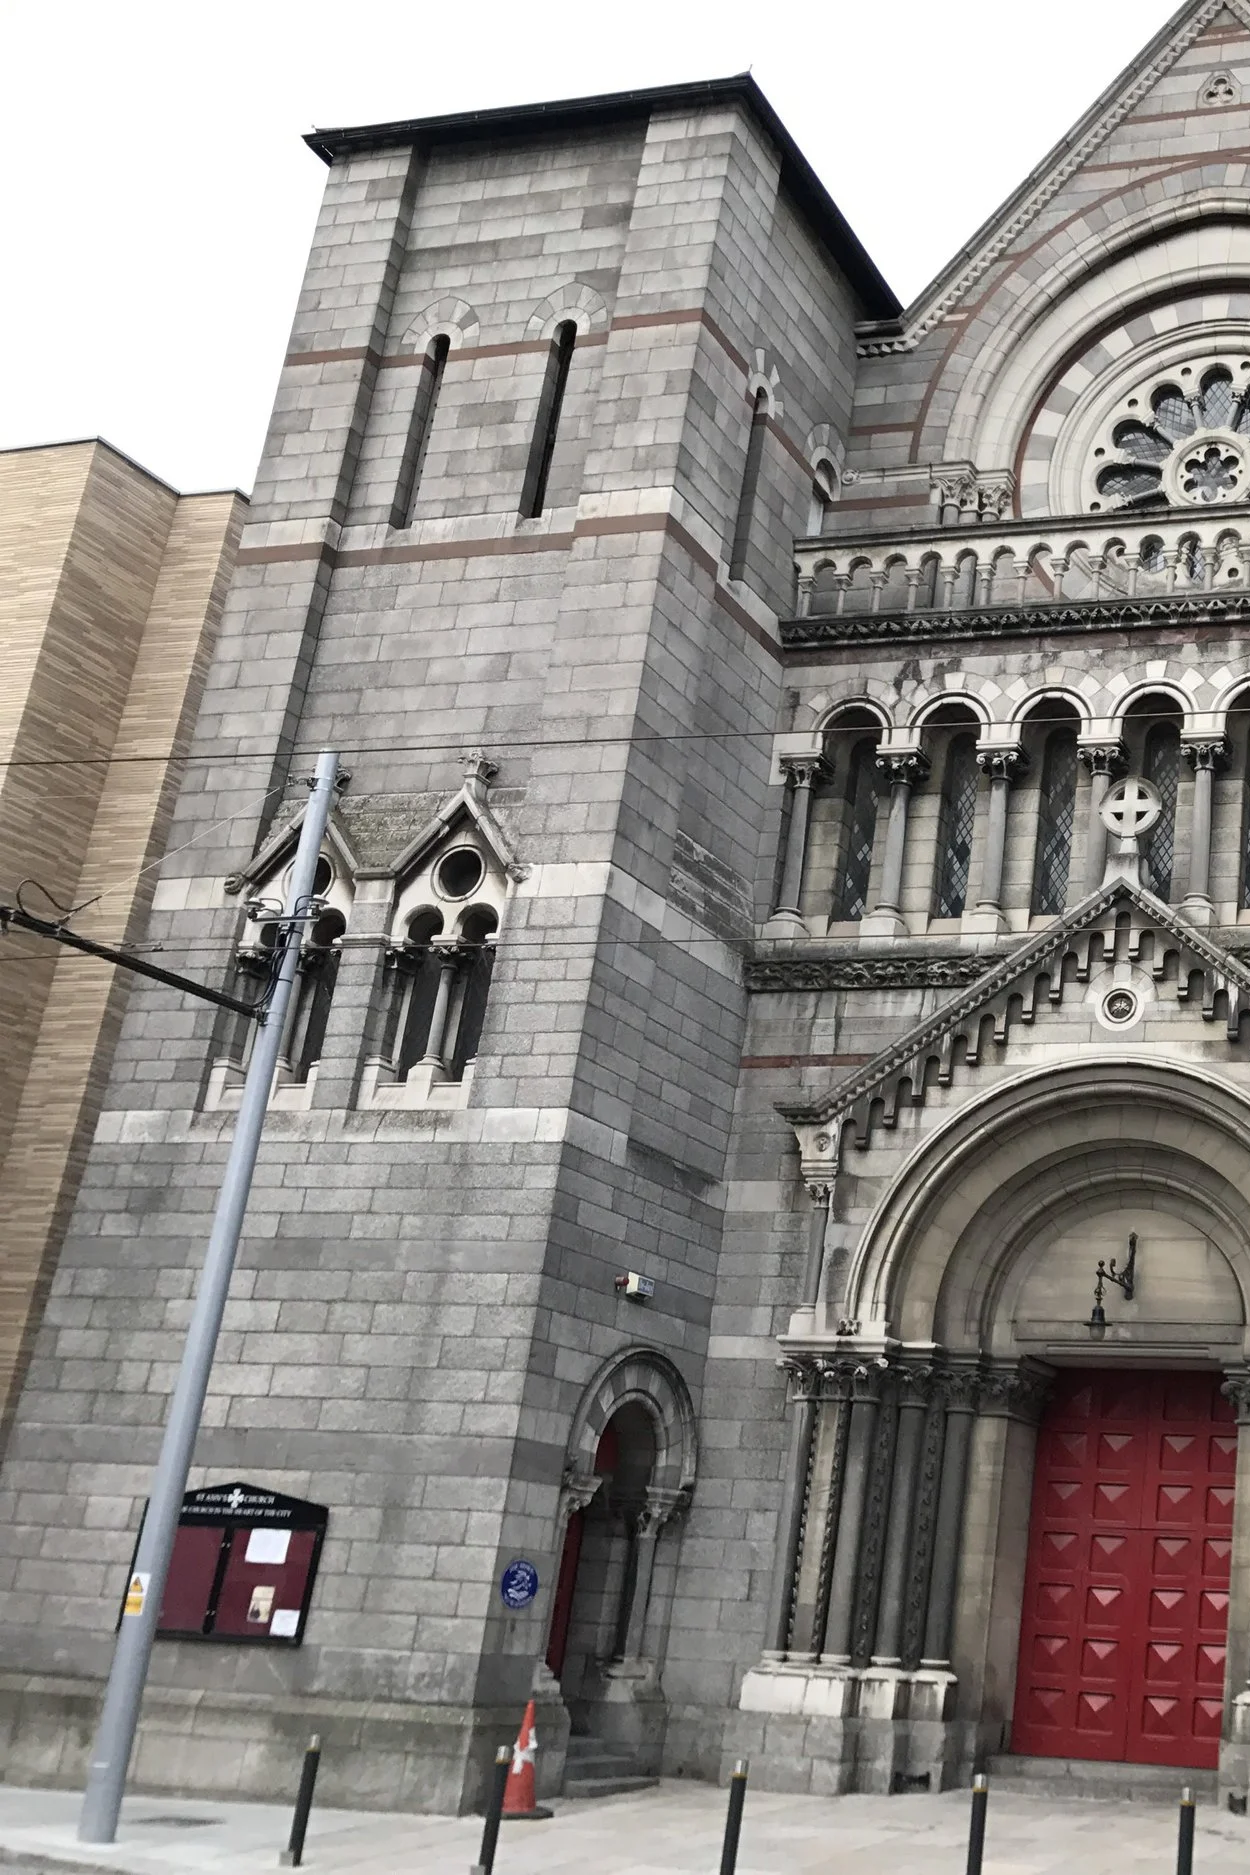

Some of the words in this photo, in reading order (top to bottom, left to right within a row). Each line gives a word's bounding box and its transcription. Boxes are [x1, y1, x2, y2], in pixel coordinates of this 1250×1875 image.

[244, 1495, 276, 1504] CHURCH
[188, 1506, 213, 1514] CHURCH
[276, 1510, 292, 1518] CITY
